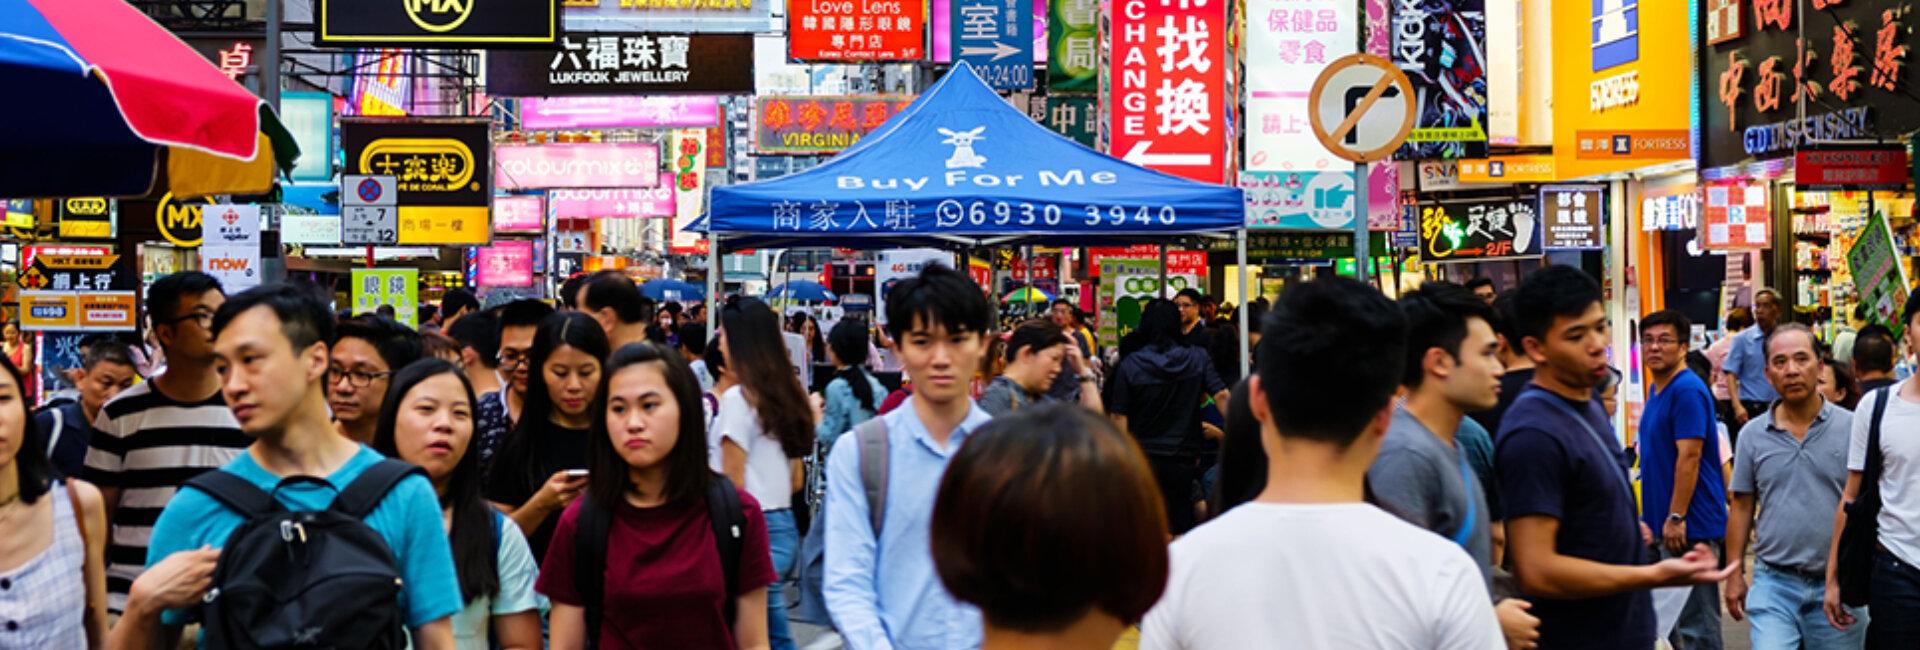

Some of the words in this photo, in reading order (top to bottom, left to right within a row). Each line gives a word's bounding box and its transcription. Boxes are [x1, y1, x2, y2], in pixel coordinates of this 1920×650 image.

[812, 0, 843, 14] Love
[852, 0, 902, 14] Lens
[802, 16, 911, 31] 韓國隱形眼鏡
[960, 3, 999, 39] 室
[1266, 8, 1337, 32] 保健品
[831, 35, 883, 48] 專門店
[549, 36, 690, 69] 六福珠寶
[1279, 39, 1326, 64] 零食
[1122, 1, 1146, 135] CHANGE
[1155, 0, 1212, 135] 找換
[548, 72, 609, 83] LUKFOOK
[614, 71, 690, 82] JEWELLERY
[1262, 113, 1309, 134] 請上
[783, 133, 860, 147] VIRGINIA
[1634, 138, 1687, 150] FORTRESS
[837, 174, 929, 191] Buy
[944, 169, 1024, 187] For
[1038, 168, 1118, 186] Me
[377, 207, 386, 221] 7
[770, 198, 915, 230] 商家入駐
[969, 200, 1062, 225] 6930
[1084, 203, 1177, 226] 3940
[378, 229, 395, 241] 12
[1486, 240, 1511, 254] 2/F
[209, 256, 249, 271] now
[364, 275, 405, 293] 眼鏡
